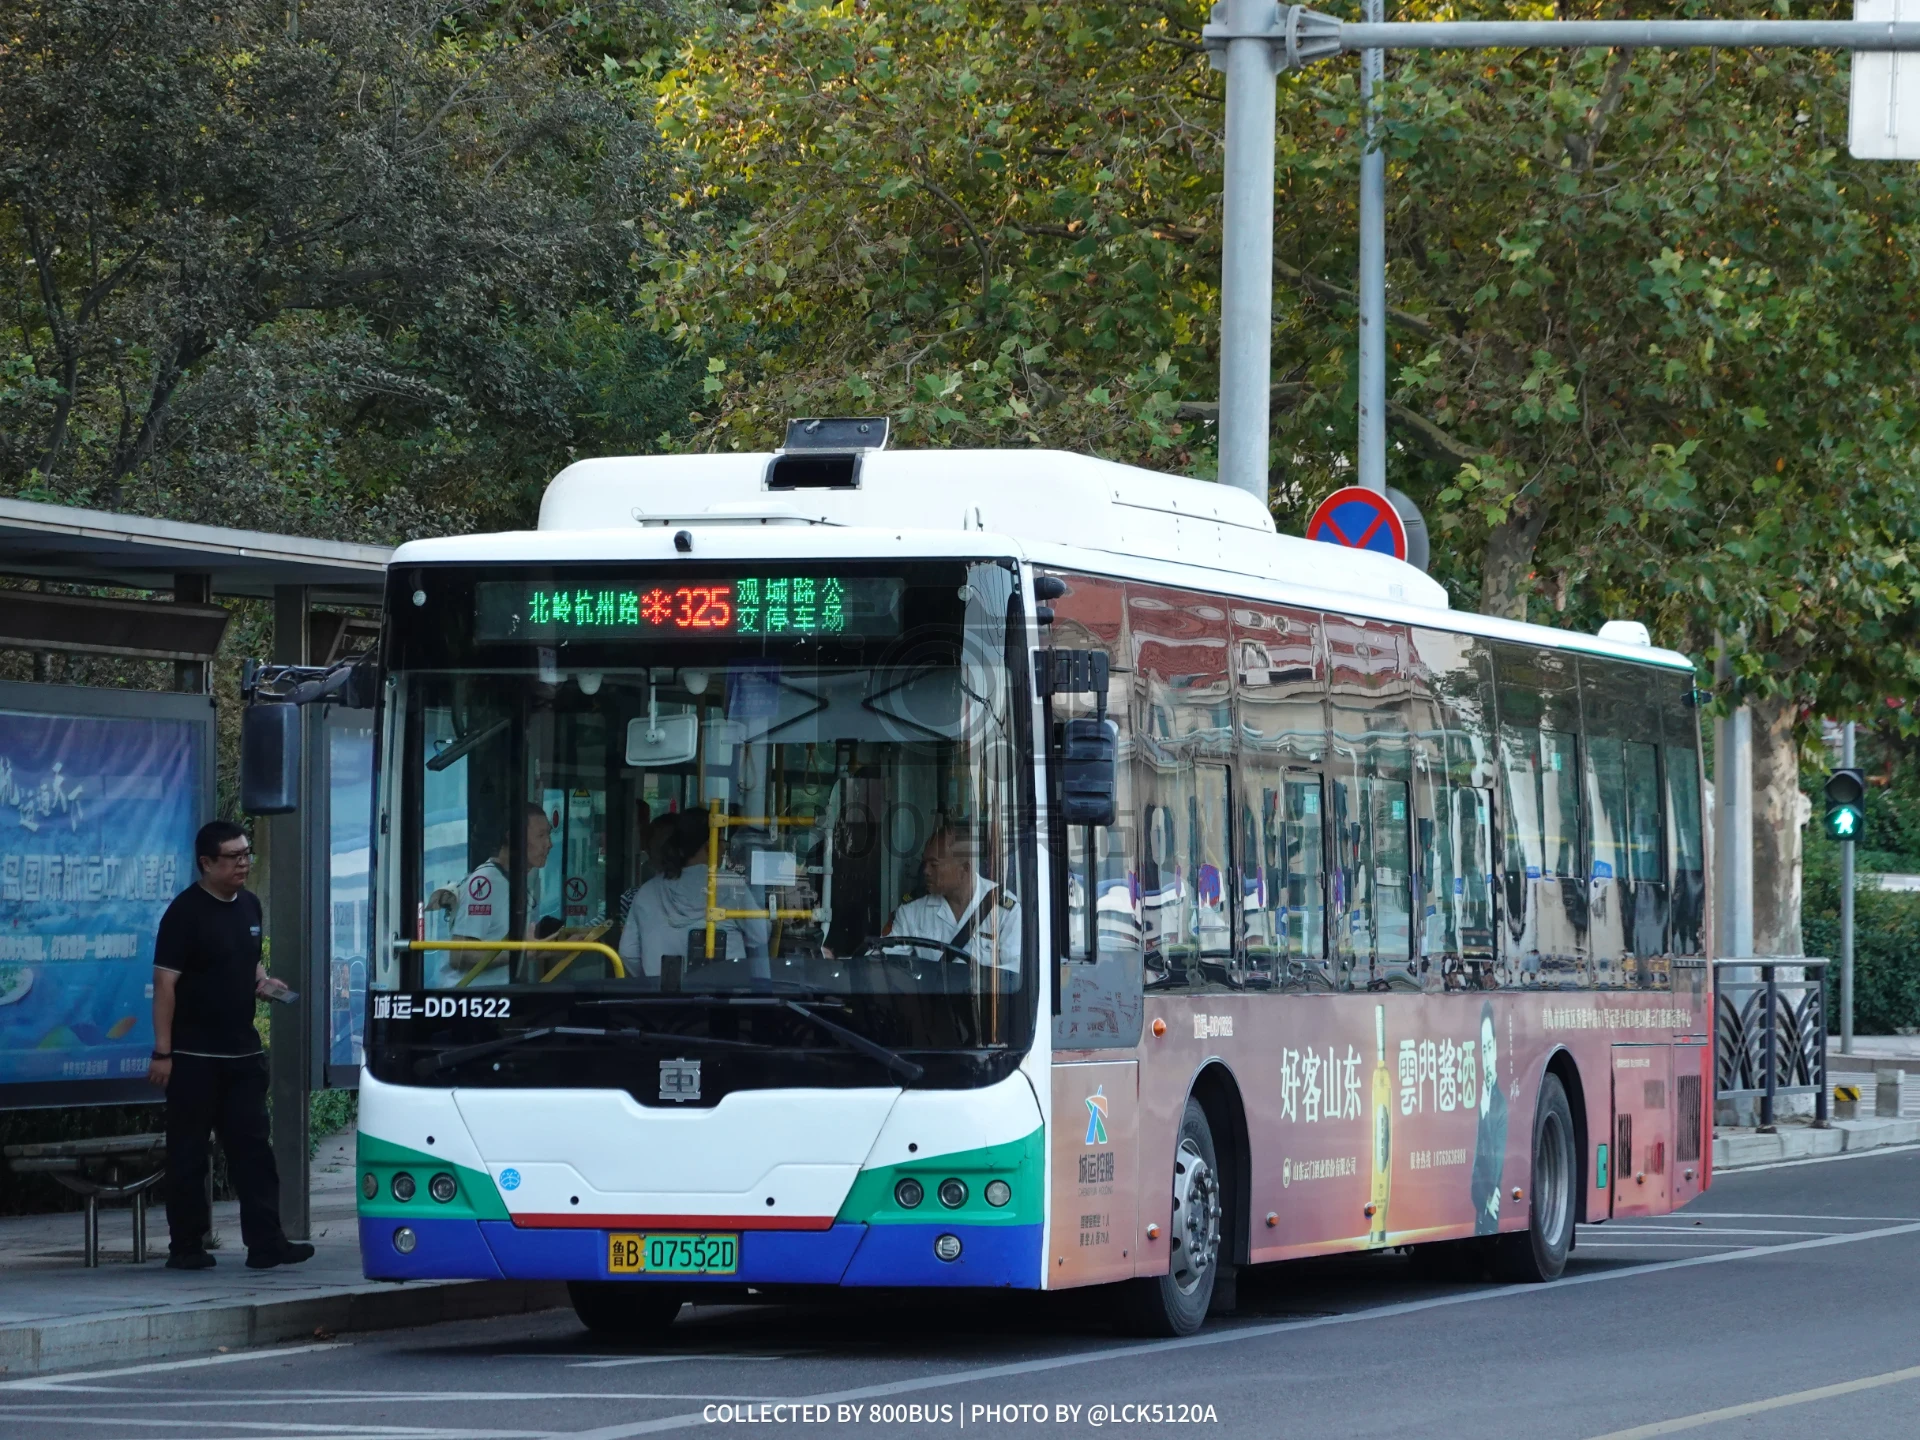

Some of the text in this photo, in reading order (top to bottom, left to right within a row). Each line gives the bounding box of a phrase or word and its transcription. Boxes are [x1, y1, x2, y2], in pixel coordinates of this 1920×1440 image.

[737, 577, 844, 604] 观城路公
[529, 590, 638, 625] 北岭杭州路
[675, 588, 730, 627] 325
[737, 605, 844, 632] 交停车场
[373, 995, 511, 1019] 城运-DD1522
[1280, 1043, 1362, 1124] 好客山东
[1078, 1151, 1115, 1184] 城运控股
[612, 1240, 734, 1267] 鲁B 07552D
